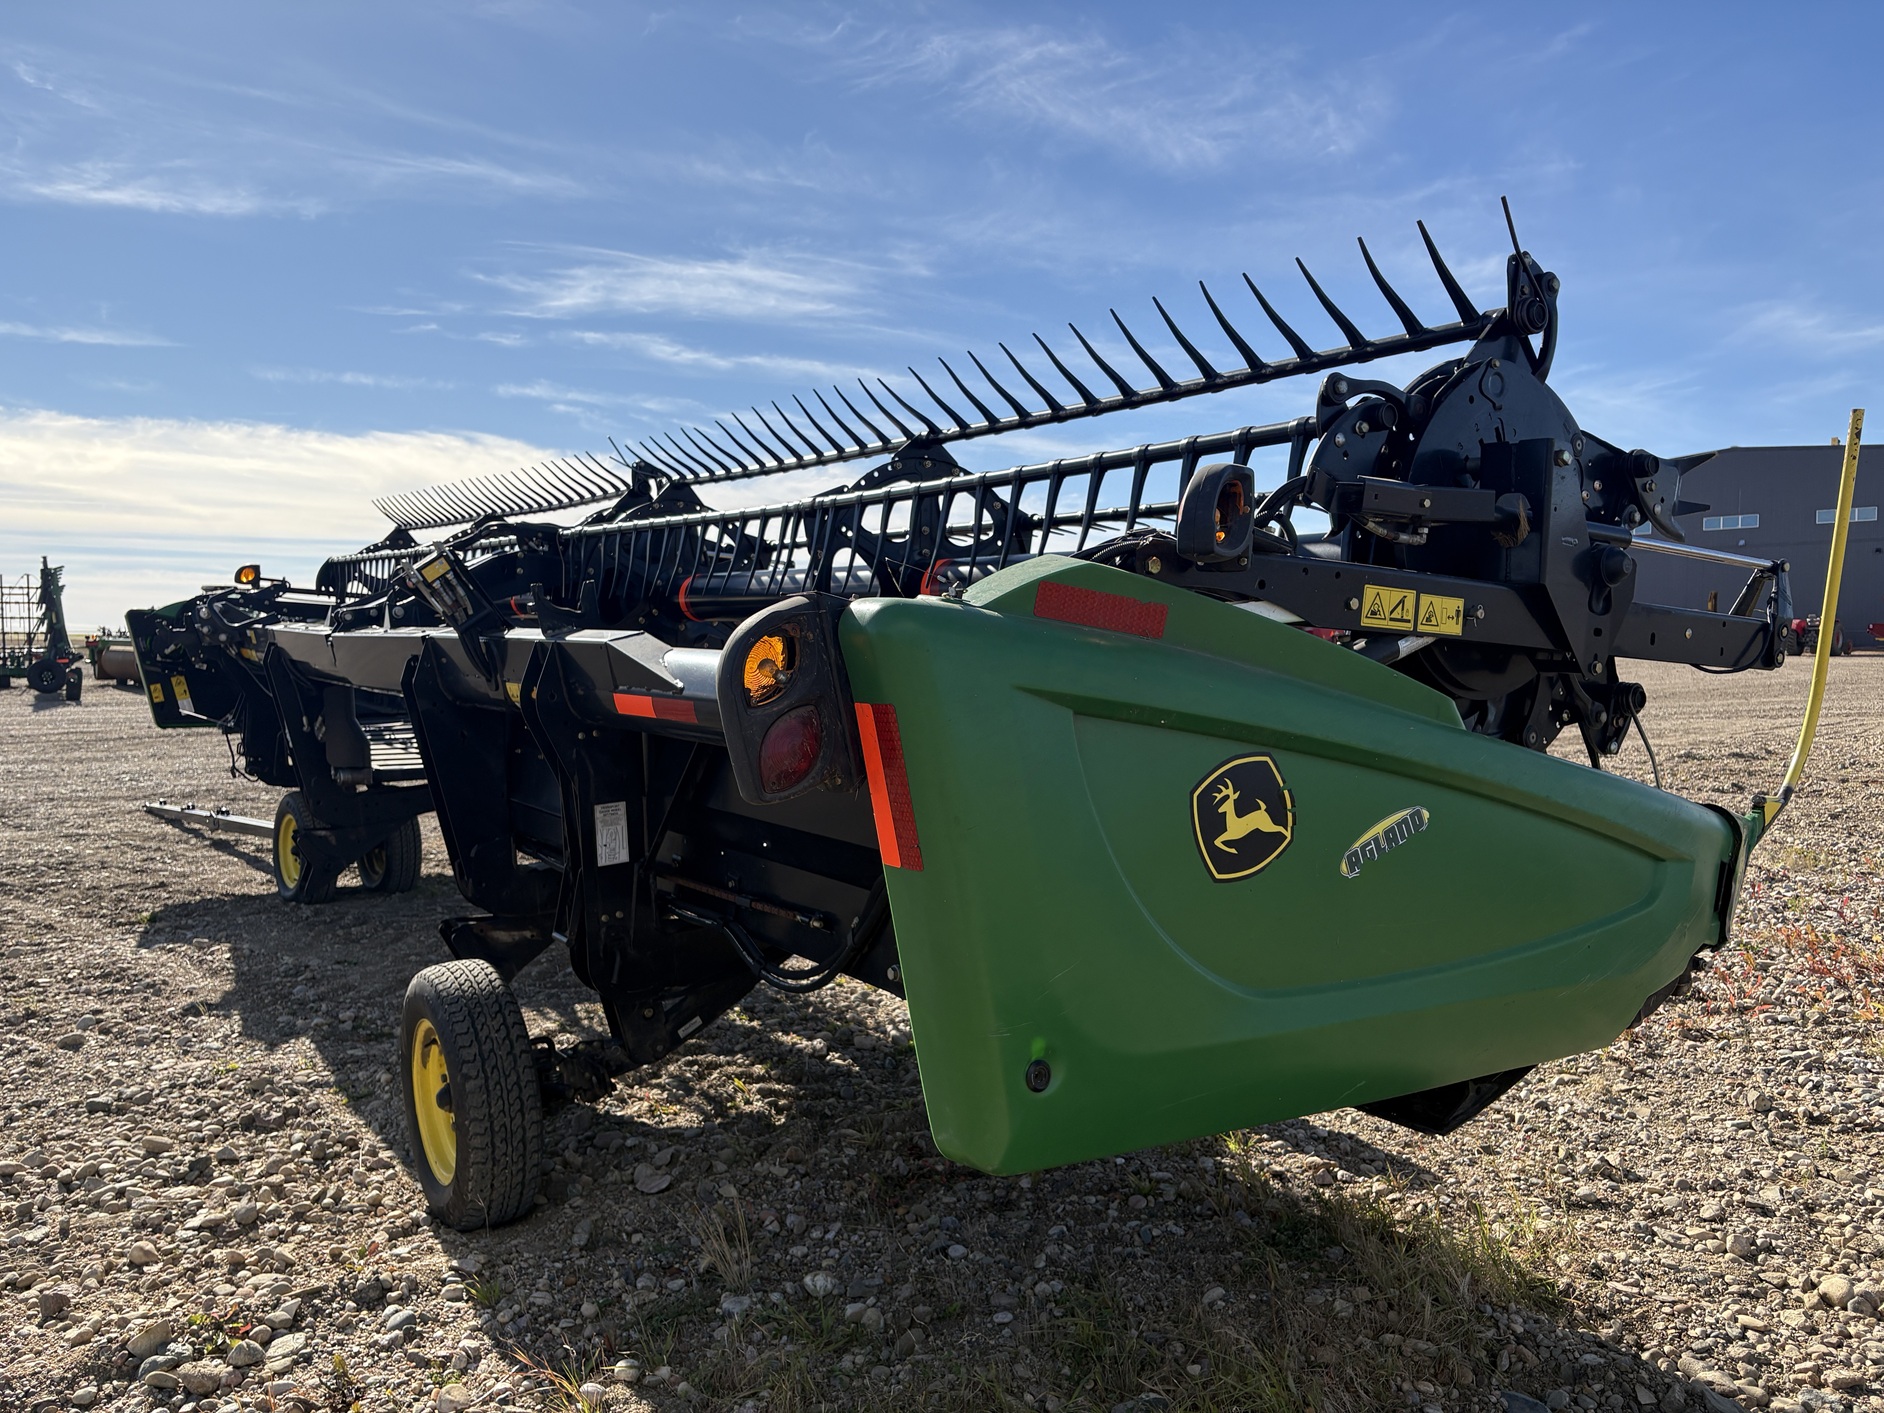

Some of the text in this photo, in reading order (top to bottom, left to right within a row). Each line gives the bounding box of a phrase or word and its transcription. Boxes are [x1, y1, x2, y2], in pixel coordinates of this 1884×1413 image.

[1474, 422, 1480, 432] 2
[1457, 442, 1464, 450] 3
[1344, 806, 1427, 878] AGLAND
